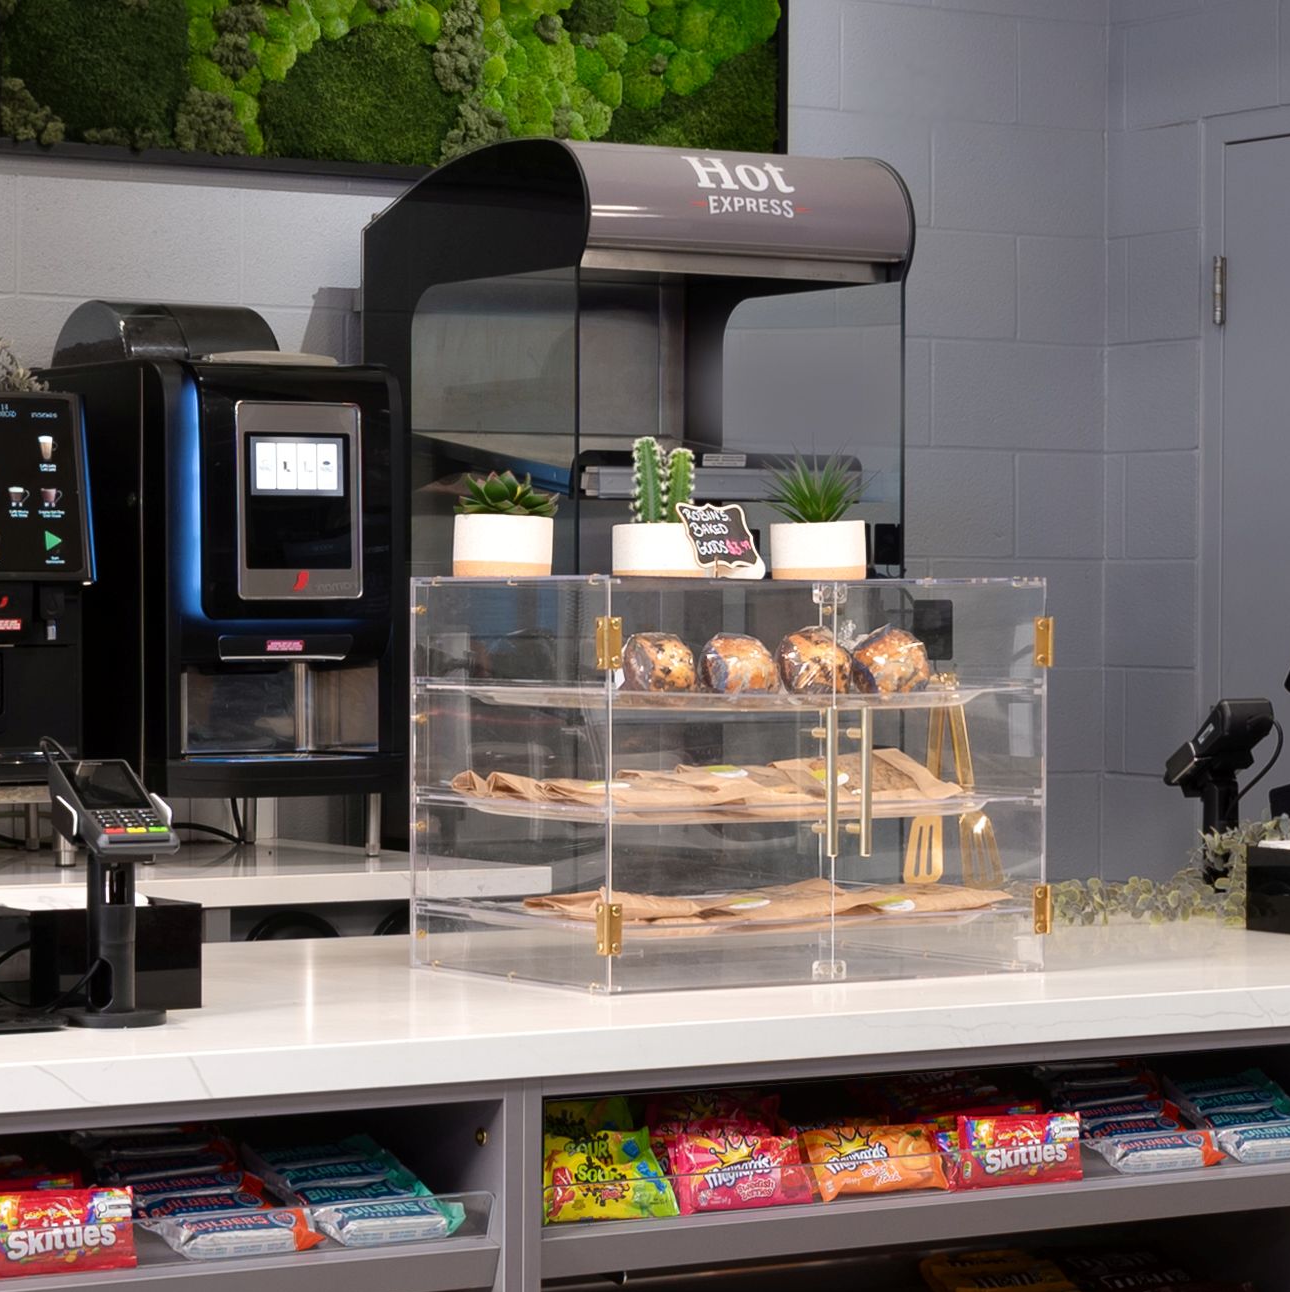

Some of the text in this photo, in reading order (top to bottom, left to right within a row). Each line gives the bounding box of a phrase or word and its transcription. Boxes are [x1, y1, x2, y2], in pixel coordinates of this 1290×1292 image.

[680, 155, 796, 194] Hot
[708, 195, 794, 219] EXPRESS
[689, 522, 729, 537] BAKED
[695, 540, 729, 556] GOODS
[1119, 1133, 1184, 1151] BUILDERS
[824, 1141, 889, 1175] Maynards
[984, 1138, 1068, 1174] Skittles
[704, 1152, 772, 1189] Maynards
[874, 1171, 902, 1186] Peach
[736, 1177, 776, 1196] Swedish
[183, 1212, 270, 1233] BUILDERS
[6, 1219, 117, 1262] Skittles
